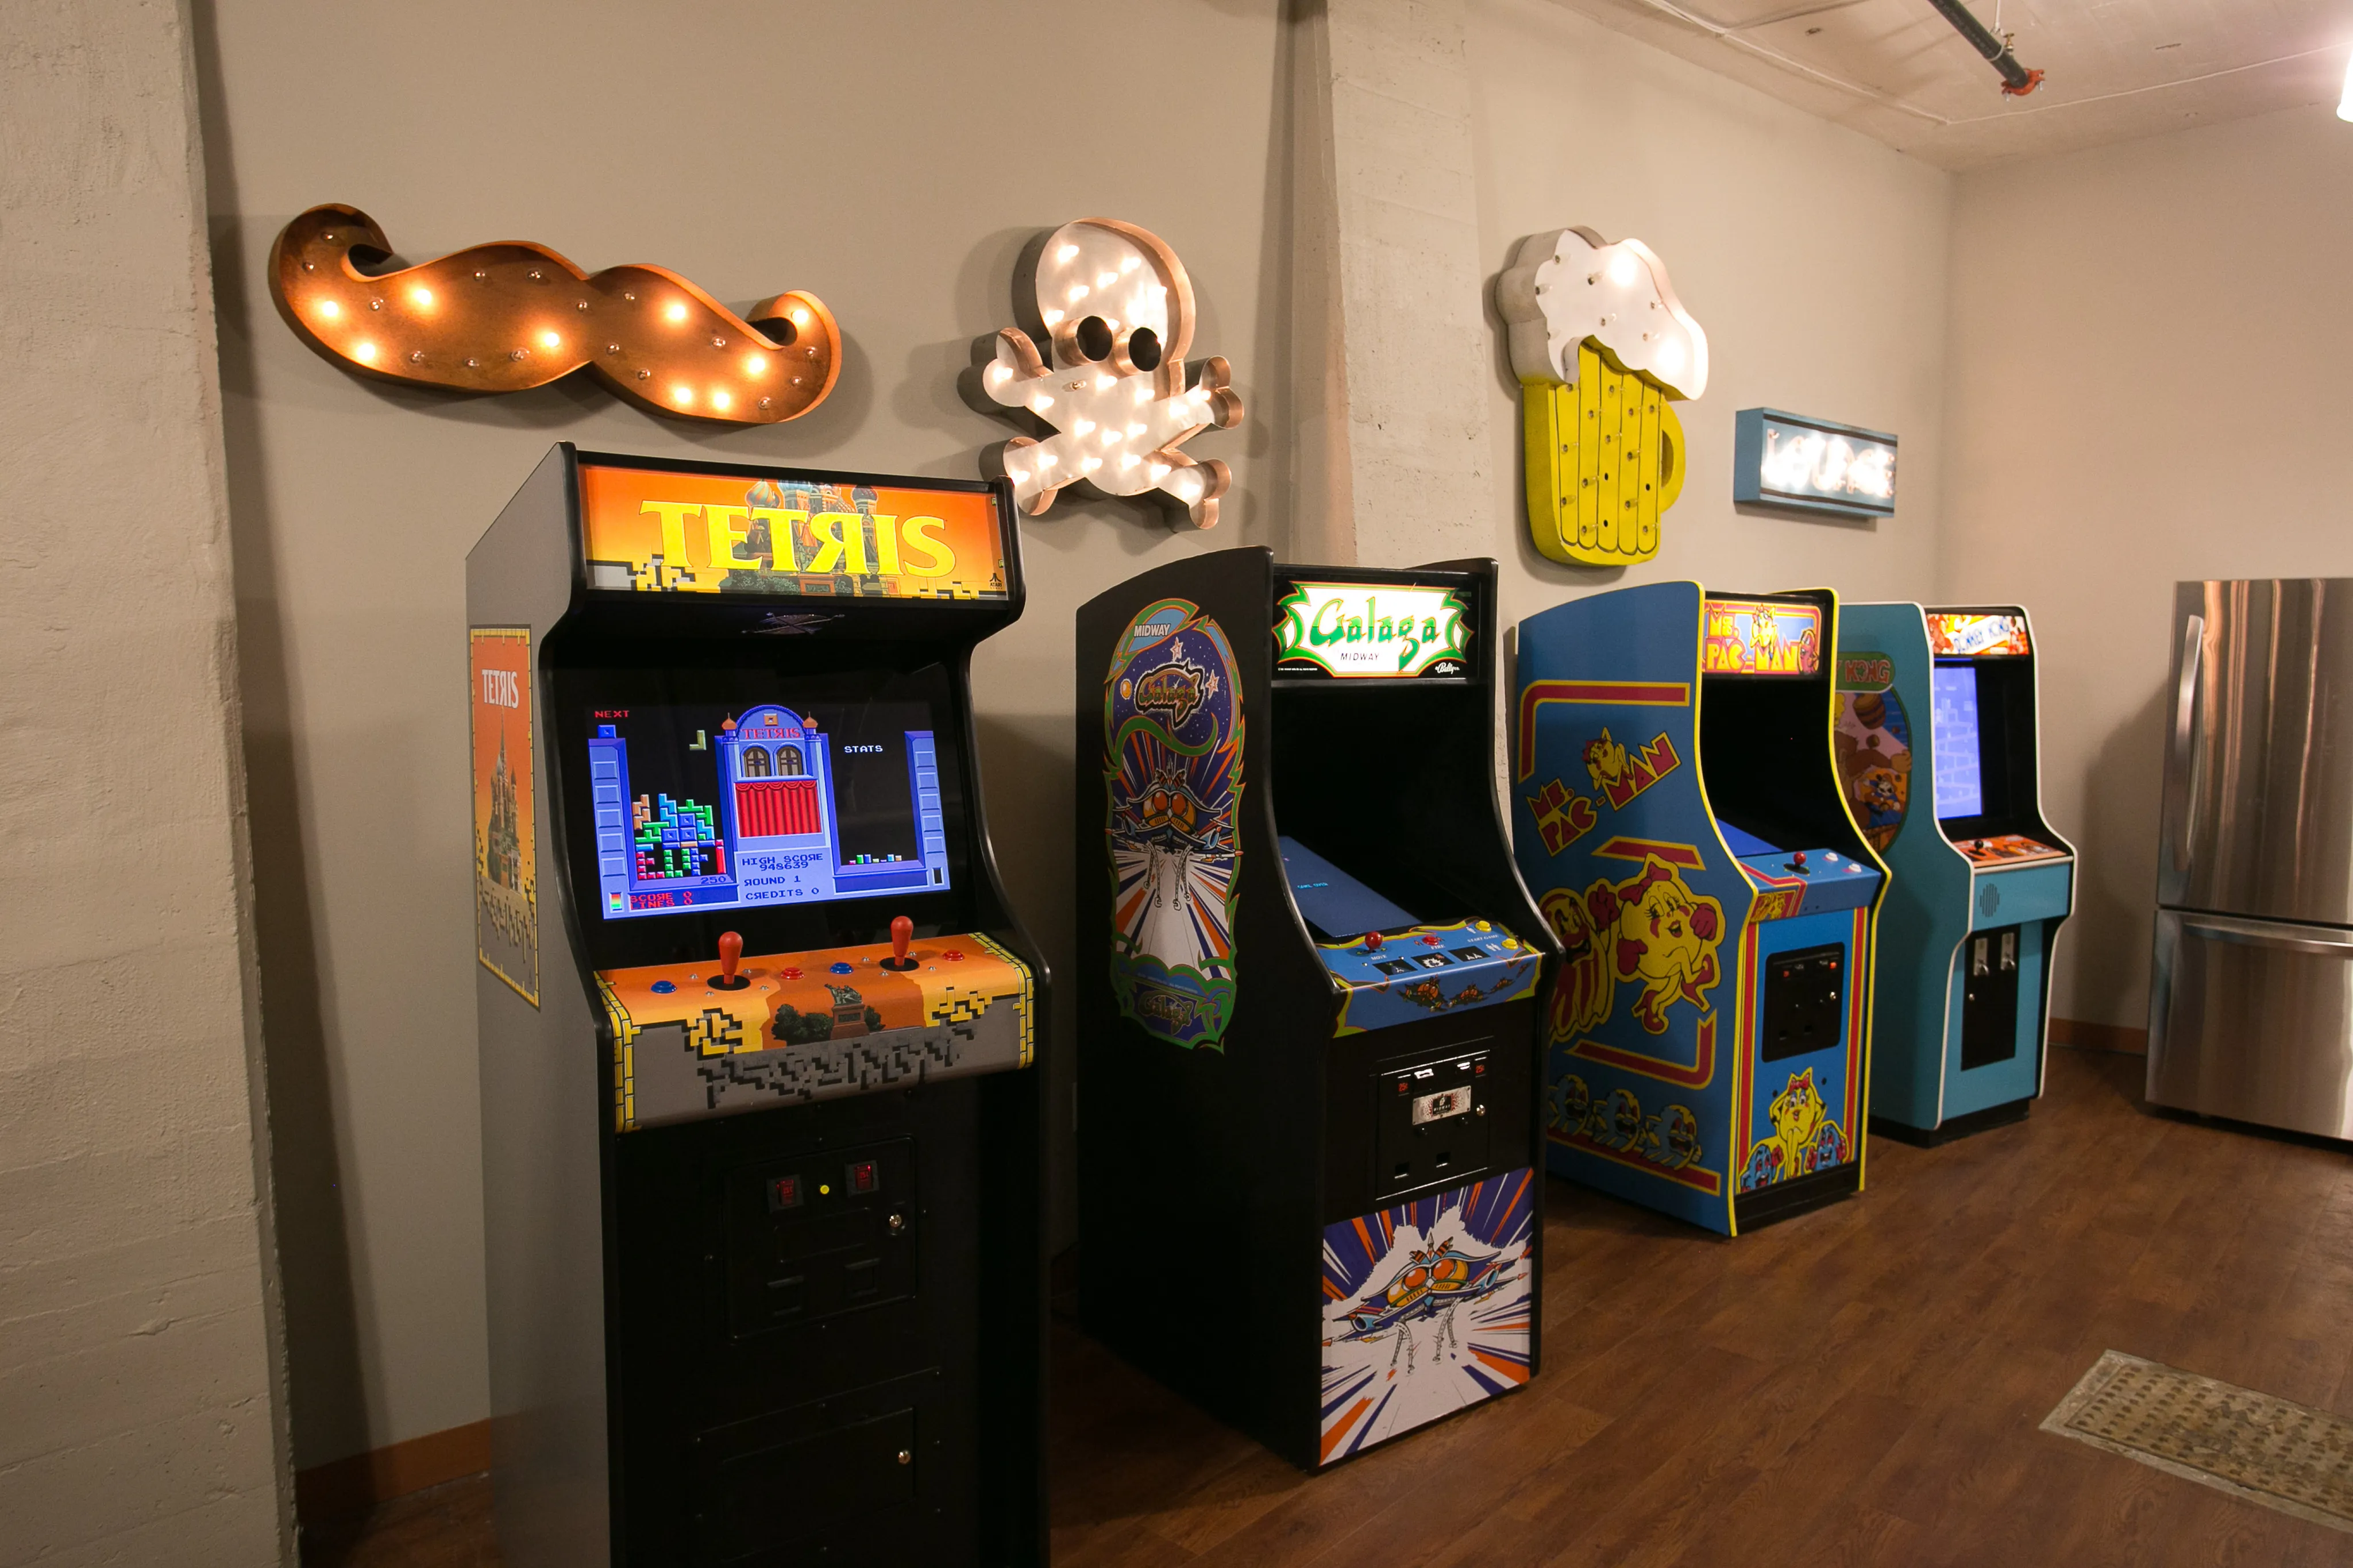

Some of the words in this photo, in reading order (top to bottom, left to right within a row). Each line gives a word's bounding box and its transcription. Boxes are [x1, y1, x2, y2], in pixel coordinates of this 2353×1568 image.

[1134, 624, 1170, 637] MIDWAY
[1309, 596, 1441, 674] Galaga
[1340, 652, 1379, 661] MIDWAY
[1845, 659, 1891, 684] KONG
[1138, 670, 1199, 722] Galaga
[595, 710, 630, 719] NEXT
[844, 745, 884, 753] STATS
[742, 856, 775, 866] HIGH
[760, 862, 809, 871] 948639
[701, 876, 727, 885] 250
[631, 899, 675, 910] LINES
